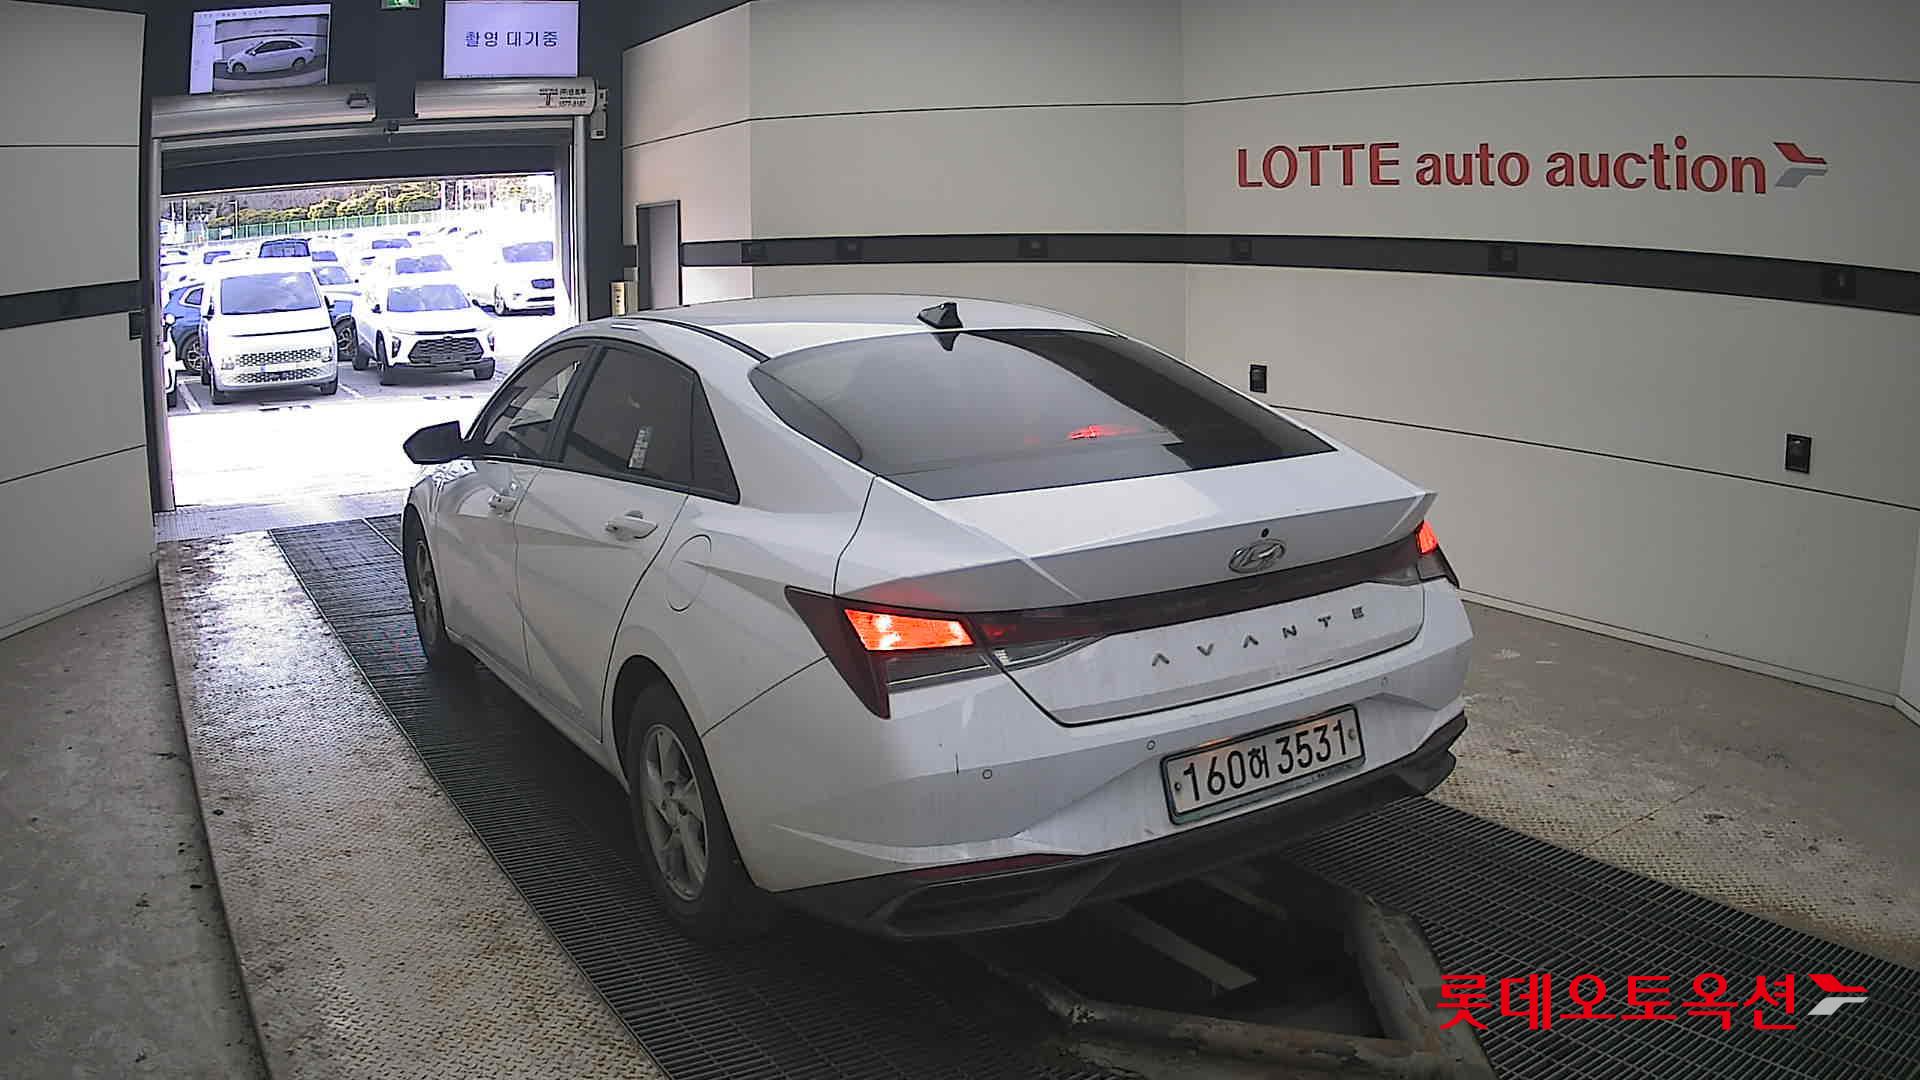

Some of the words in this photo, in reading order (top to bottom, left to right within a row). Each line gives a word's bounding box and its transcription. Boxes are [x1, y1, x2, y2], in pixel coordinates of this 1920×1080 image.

[506, 30, 558, 48] 대기중
[1237, 142, 1399, 188] LOTTE
[1416, 143, 1531, 187] auto
[1544, 136, 1768, 194] auction
[1151, 606, 1365, 668] AVANTE
